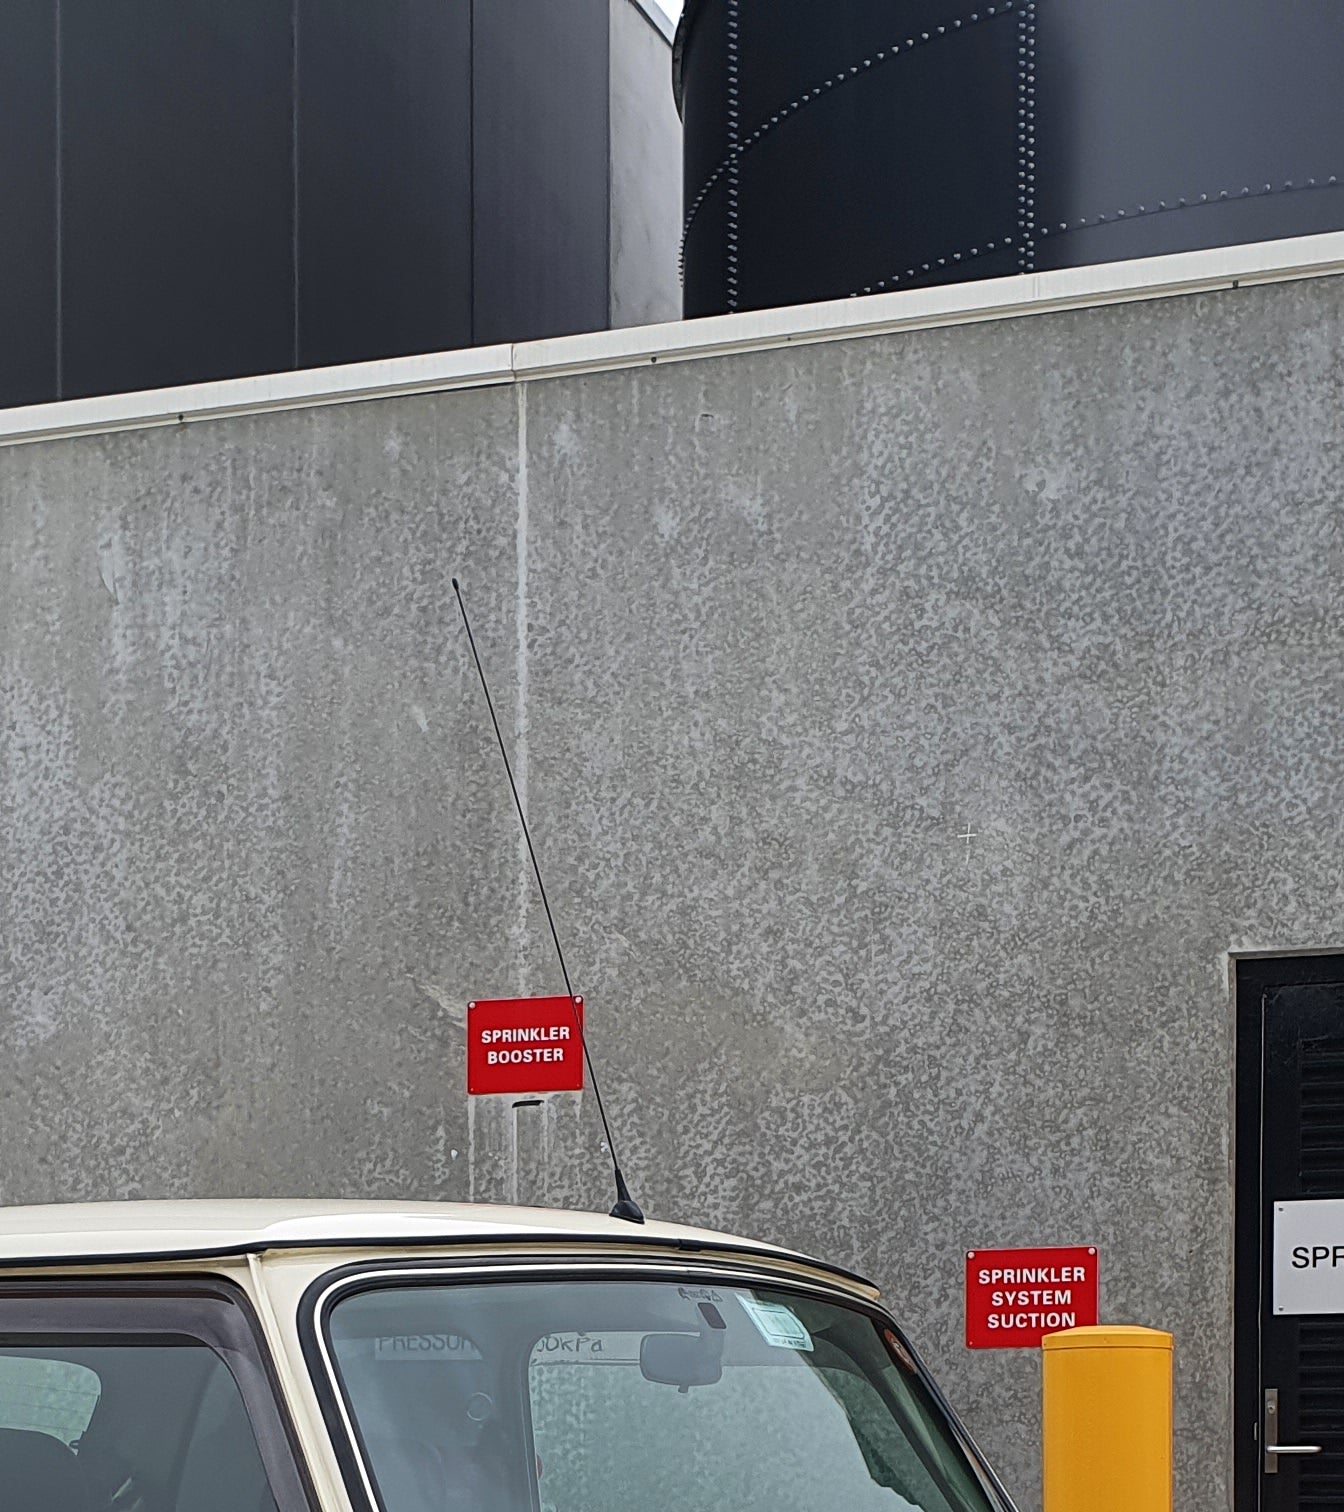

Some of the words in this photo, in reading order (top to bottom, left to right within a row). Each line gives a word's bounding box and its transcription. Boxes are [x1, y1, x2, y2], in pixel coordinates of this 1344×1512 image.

[481, 1026, 570, 1043] SPRINKLER
[487, 1048, 564, 1064] BOOSTER
[978, 1267, 1086, 1284] SPRINKLER
[991, 1290, 1072, 1306] SYSTEM
[987, 1312, 1076, 1328] SUCTION
